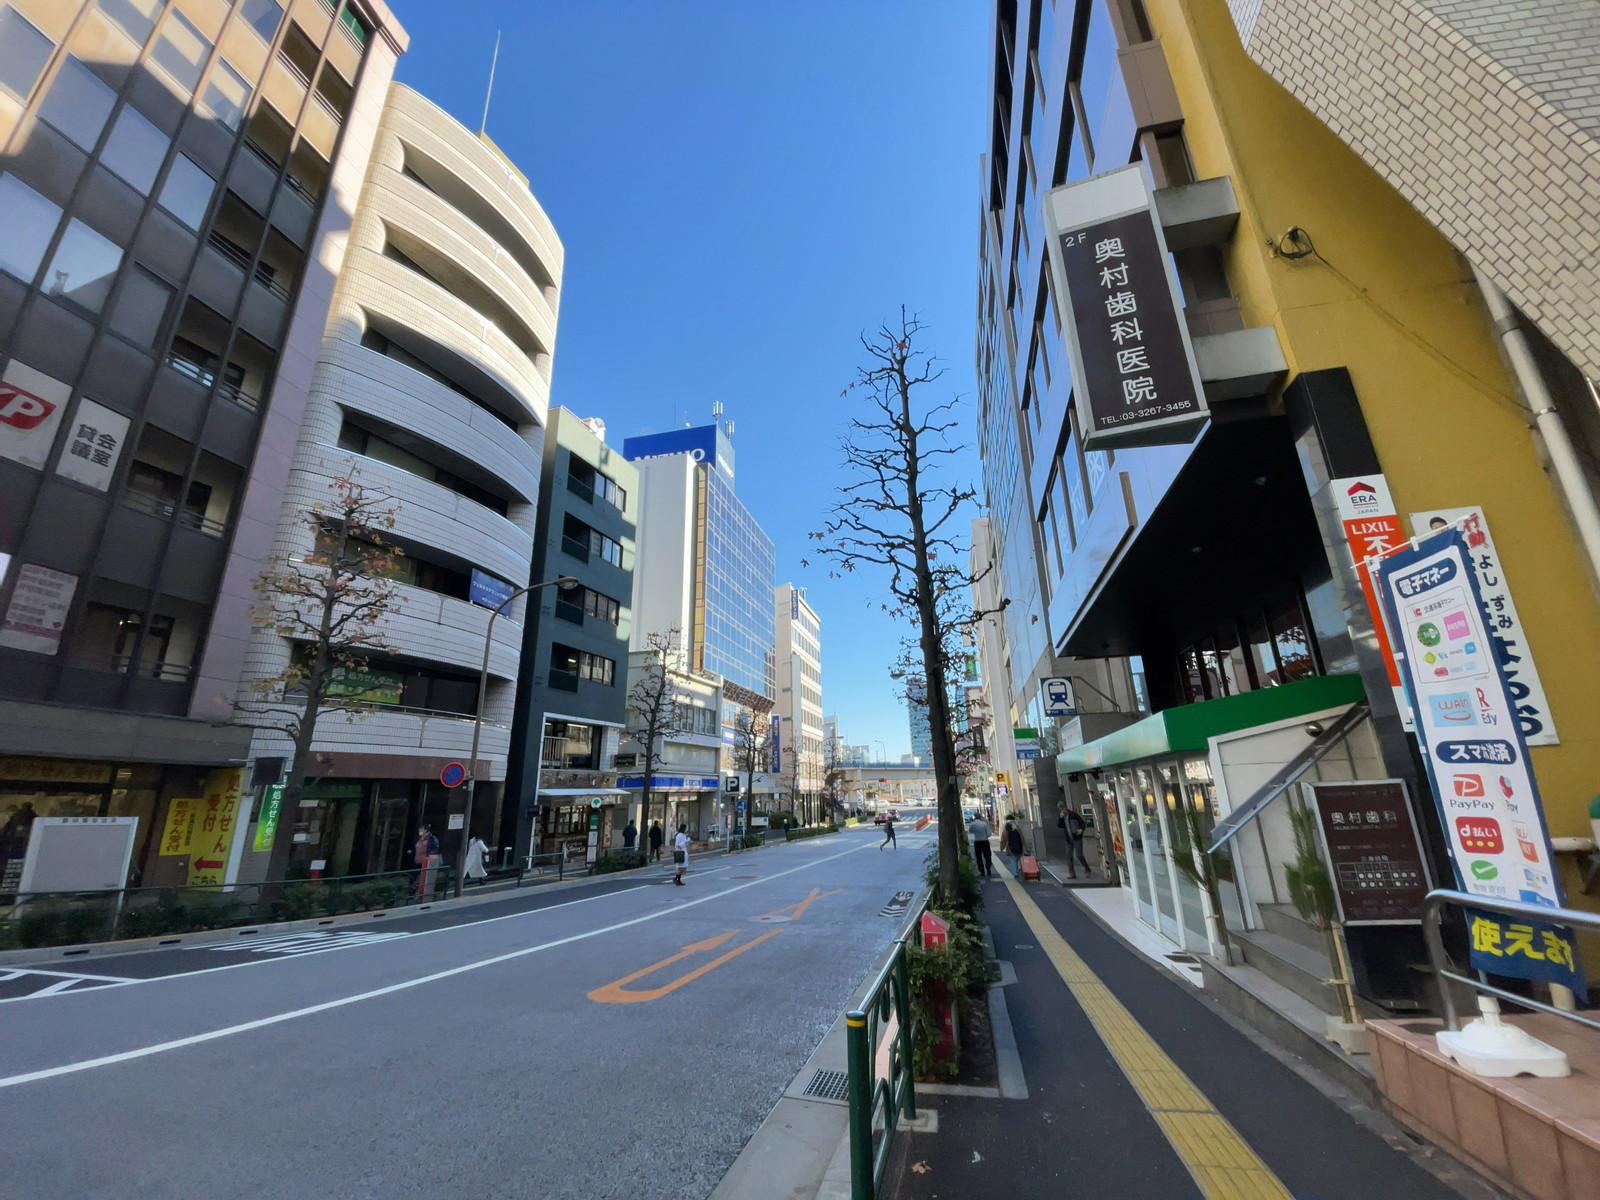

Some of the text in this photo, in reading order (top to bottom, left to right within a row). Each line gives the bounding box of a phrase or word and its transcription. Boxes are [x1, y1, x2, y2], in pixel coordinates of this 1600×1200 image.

[1065, 233, 1087, 247] 2F
[1095, 237, 1157, 405] 奥村歯科医院
[1351, 495, 1377, 504] ERA
[1351, 521, 1395, 535] LIXIL
[1399, 566, 1449, 595] 電子マネー
[1479, 554, 1513, 629] よしずみ
[1481, 713, 1497, 725] Edy
[727, 778, 738, 791] P
[1449, 800, 1495, 810] PayPay
[203, 794, 221, 832] 受付
[213, 774, 240, 853] 処方せん
[263, 790, 282, 847] 処方せん受付
[1331, 810, 1397, 824] 奥村歯科
[1460, 824, 1497, 837] d払い
